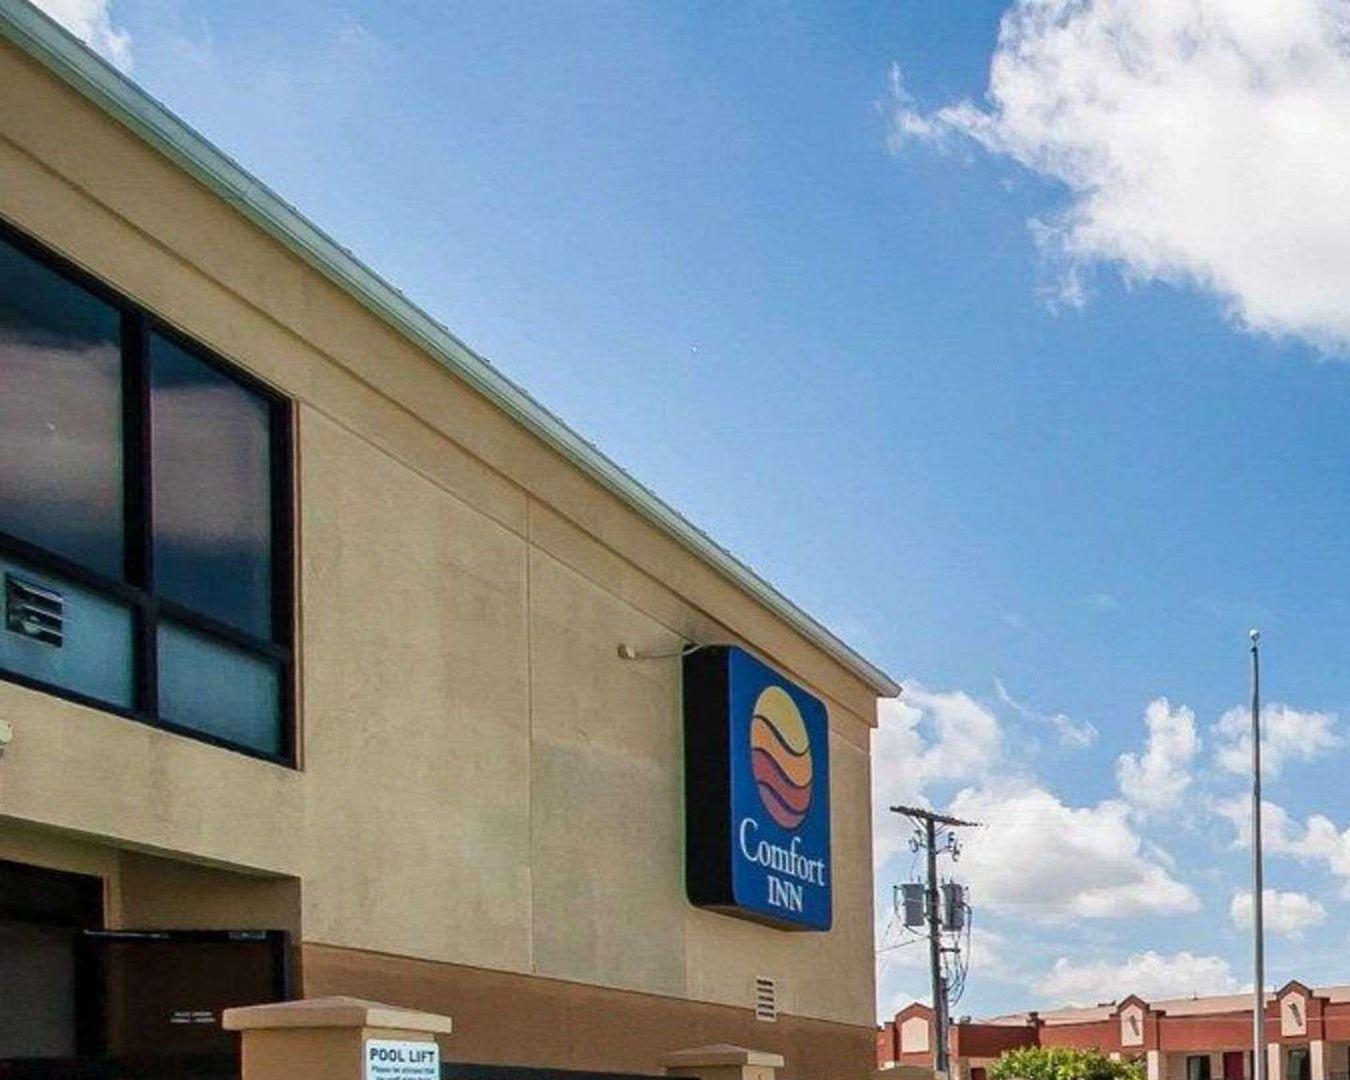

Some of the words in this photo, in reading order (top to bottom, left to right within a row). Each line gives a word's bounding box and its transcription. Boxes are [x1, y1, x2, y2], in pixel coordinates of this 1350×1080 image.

[740, 818, 825, 887] Comfort
[767, 876, 803, 913] INN
[370, 1048, 405, 1062] POOL
[409, 1050, 435, 1062] LIFT
